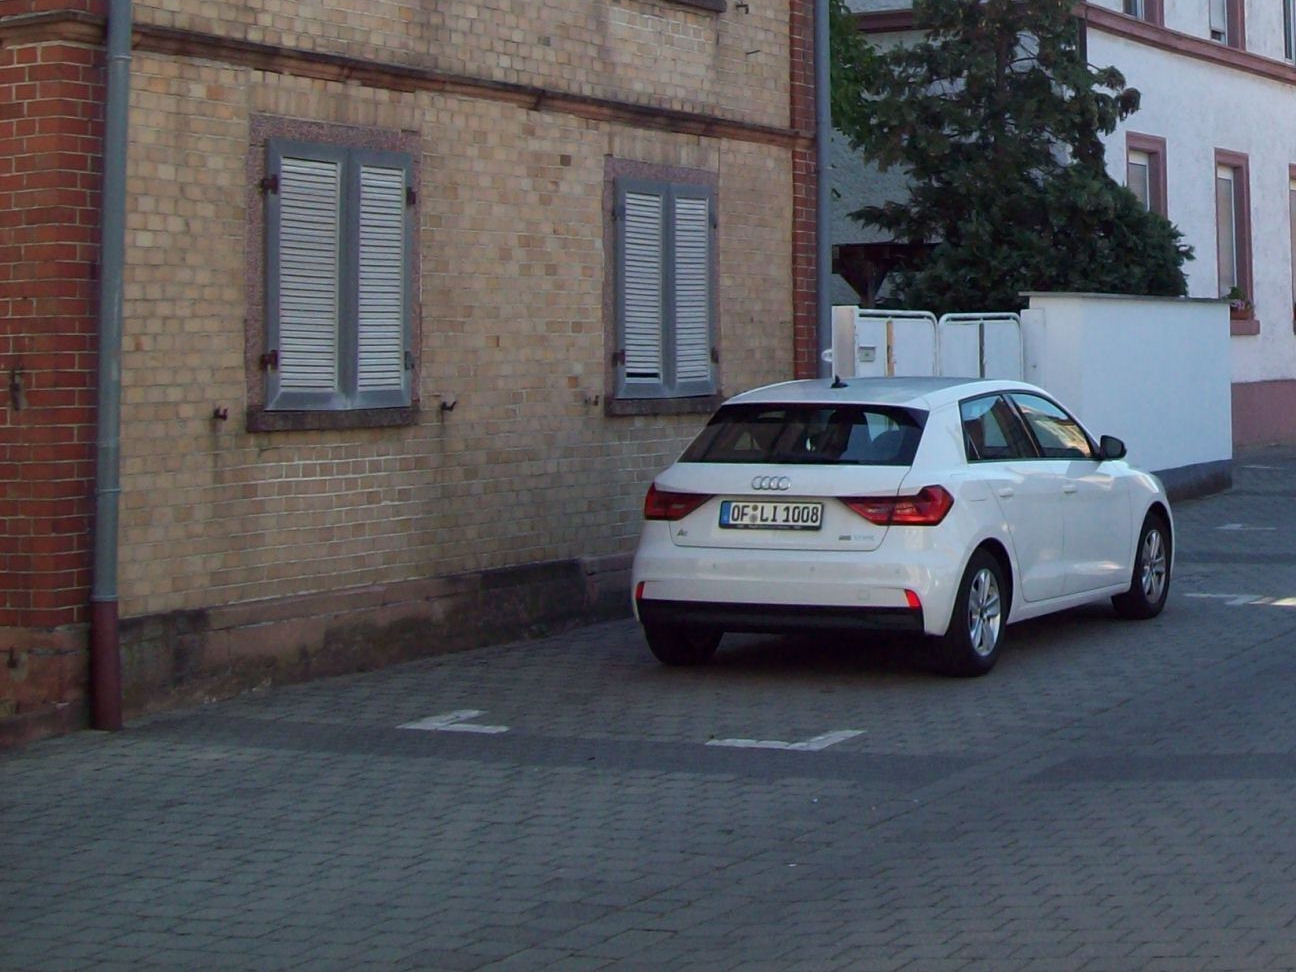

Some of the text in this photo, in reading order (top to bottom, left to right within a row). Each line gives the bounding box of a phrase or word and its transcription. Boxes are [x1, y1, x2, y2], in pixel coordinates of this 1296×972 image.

[731, 504, 819, 524] OF LI 1008
